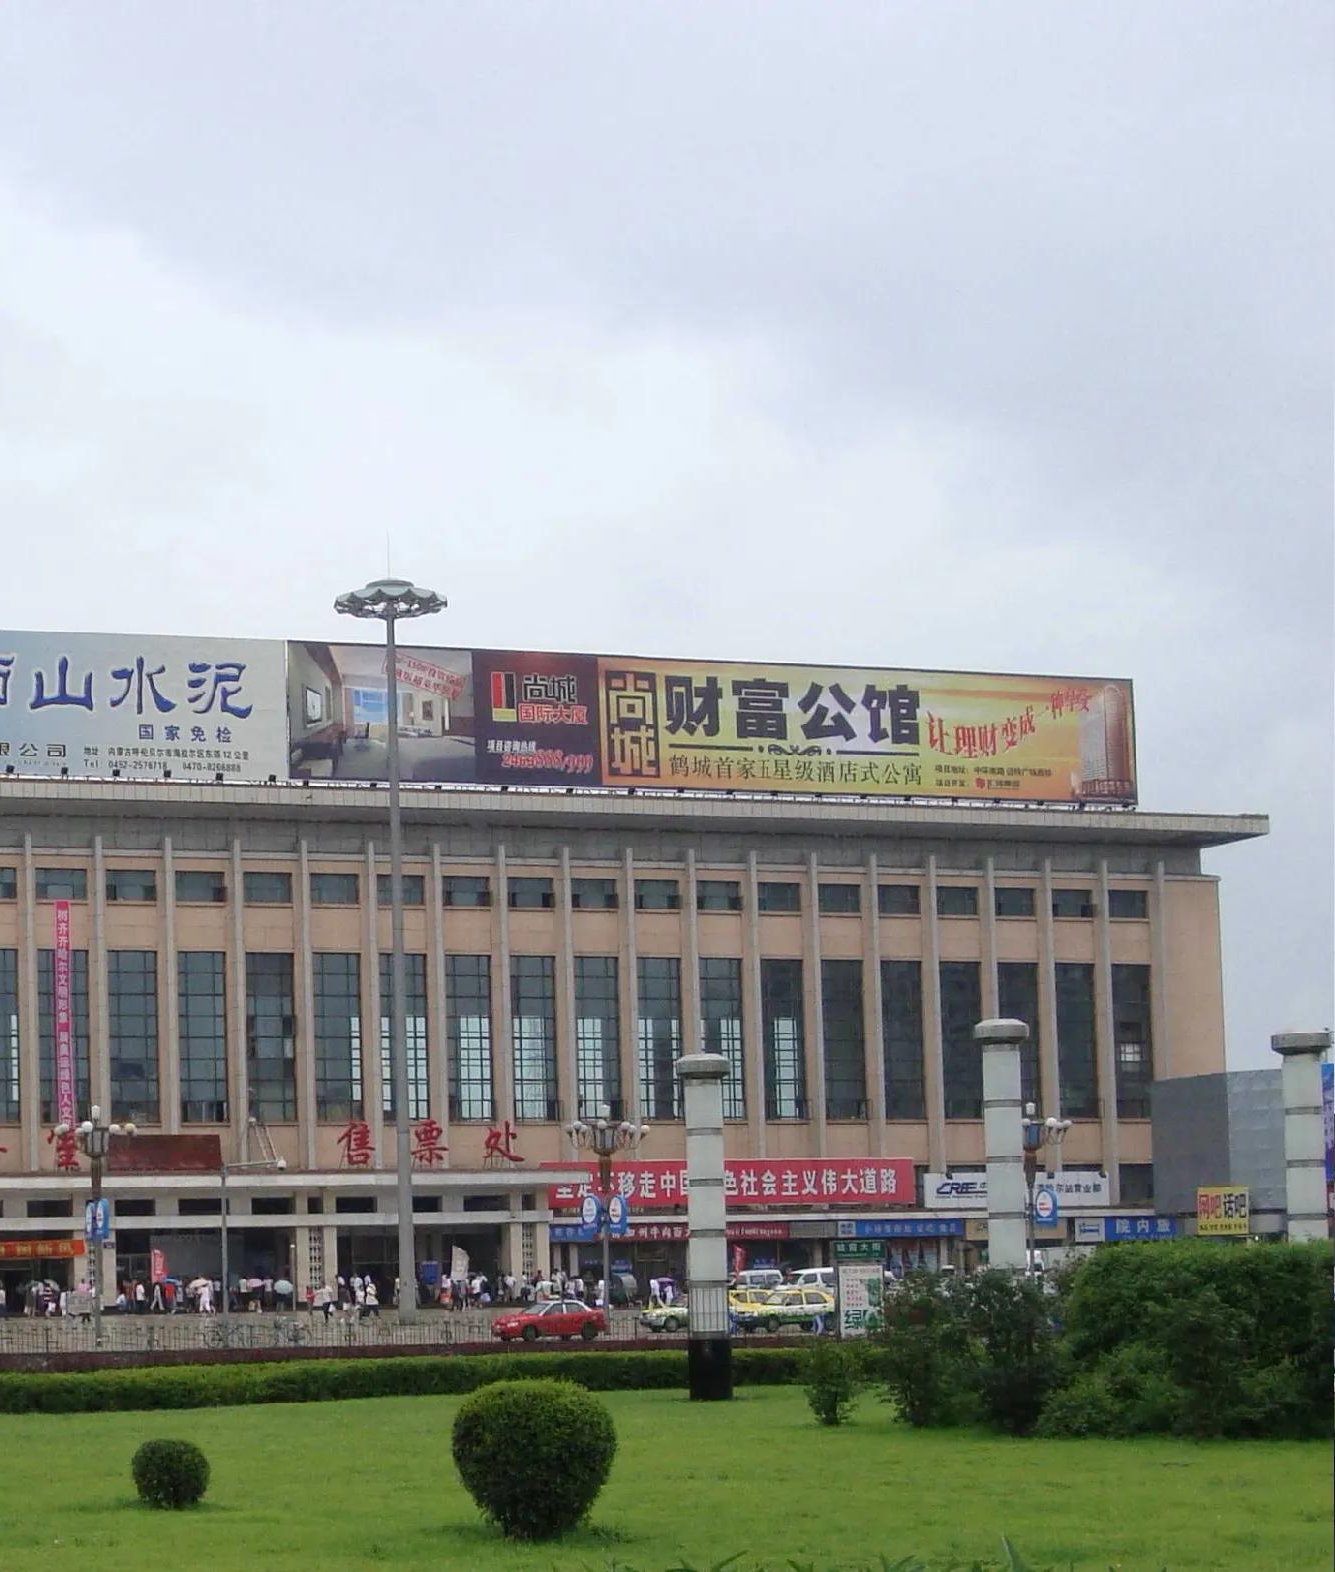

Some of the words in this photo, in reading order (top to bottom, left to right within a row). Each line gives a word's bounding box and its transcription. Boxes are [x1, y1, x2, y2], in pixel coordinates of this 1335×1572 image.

[522, 672, 578, 704] 尚城
[518, 703, 588, 725] 国际大厦
[665, 675, 921, 746] 财富公馆
[138, 724, 233, 743] 国家免检
[668, 754, 922, 785] 鹤城首家五星级酒店式公寓
[336, 1119, 526, 1167] 售票处
